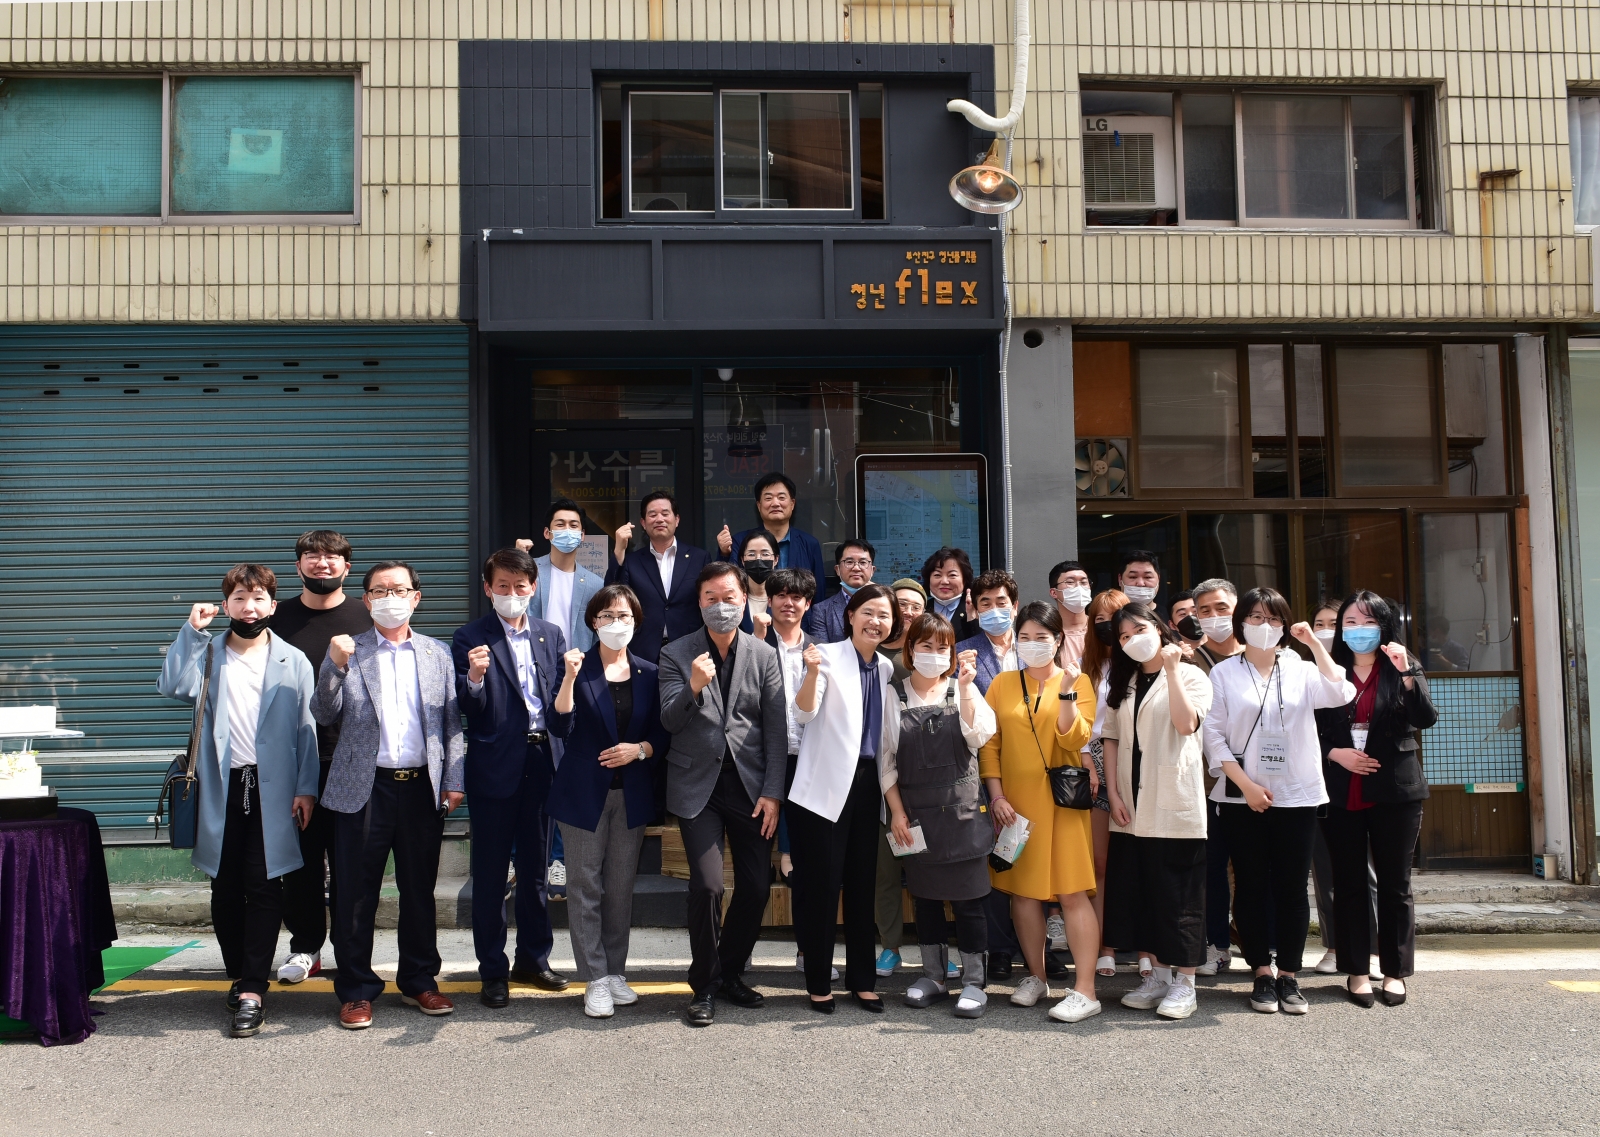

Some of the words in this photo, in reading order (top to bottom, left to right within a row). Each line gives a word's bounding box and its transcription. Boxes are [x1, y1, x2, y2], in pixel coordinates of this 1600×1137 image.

[1086, 118, 1108, 131] LG
[906, 250, 935, 264] 부산진구
[850, 283, 885, 309] 청년
[894, 268, 978, 305] flex
